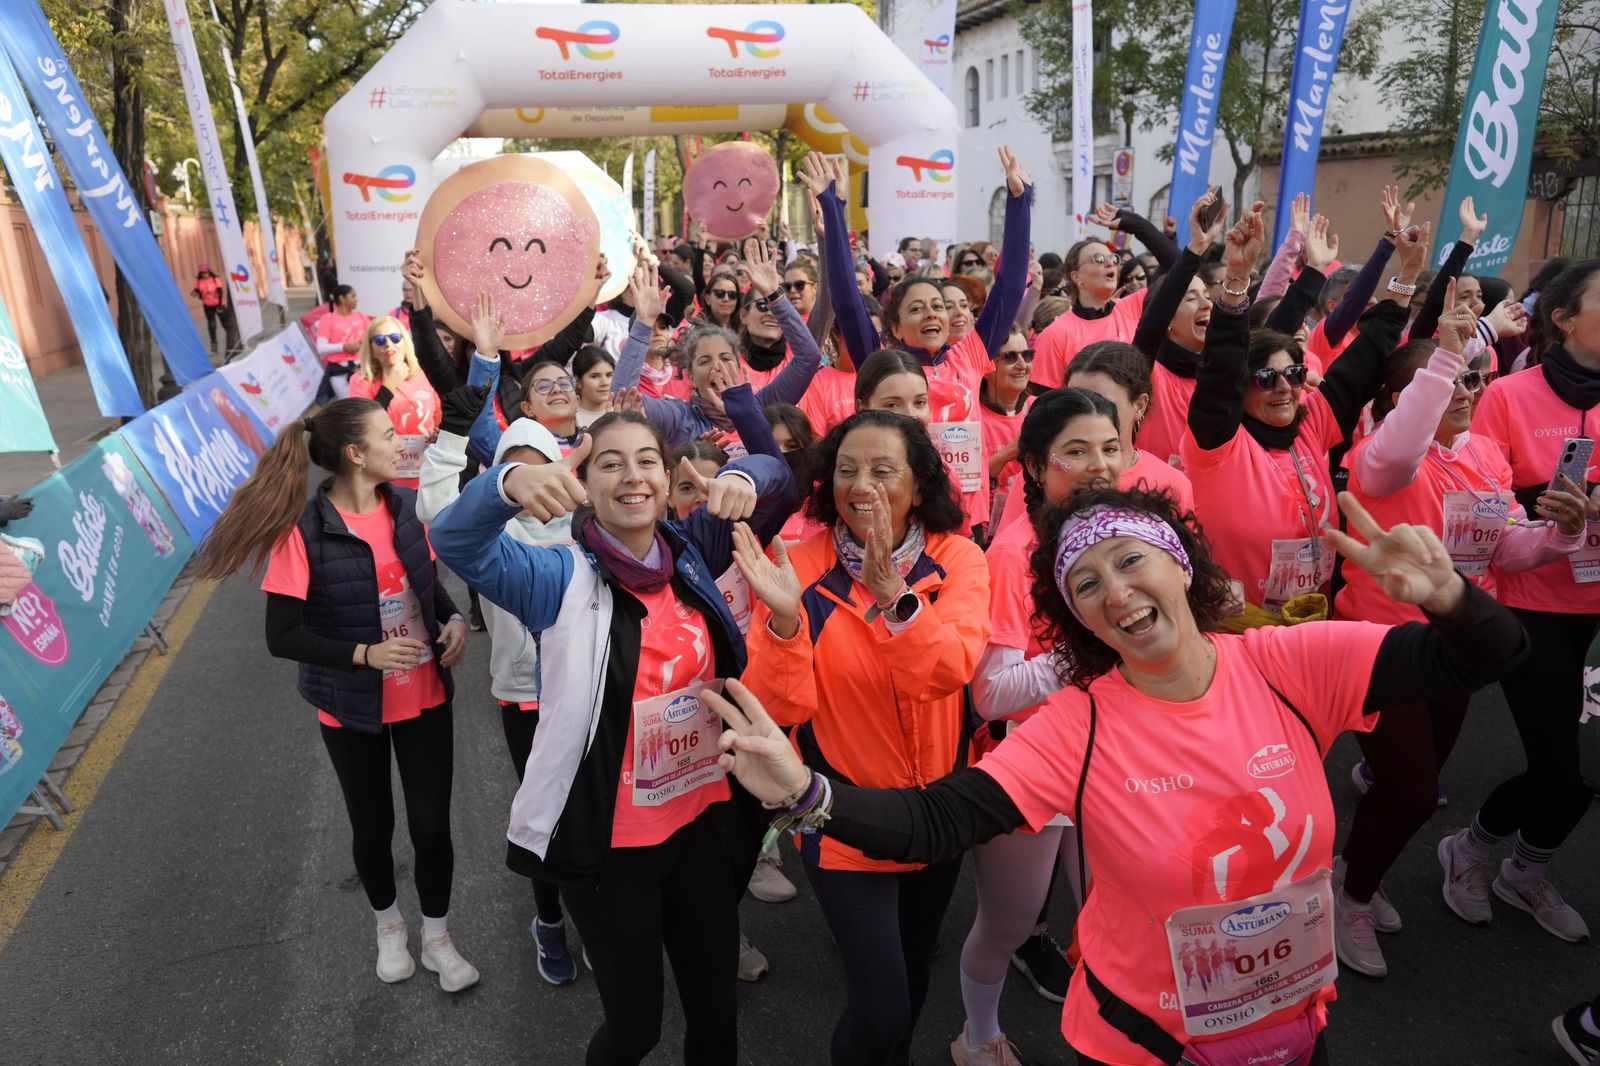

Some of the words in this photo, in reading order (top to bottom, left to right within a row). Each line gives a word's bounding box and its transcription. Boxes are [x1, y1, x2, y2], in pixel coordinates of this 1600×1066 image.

[538, 69, 623, 82] TotalEnergies
[708, 67, 787, 80] TotalEnergies
[1179, 33, 1223, 175] Marlene
[585, 114, 624, 123] Deportes
[943, 432, 969, 440] ASTURIANA
[1534, 427, 1578, 438] OYSHO
[402, 453, 419, 461] 016
[944, 452, 969, 464] 016
[1473, 529, 1499, 542] 016
[58, 490, 107, 602] Batiste
[1298, 568, 1321, 588] 016
[32, 623, 61, 653] ESPAÑA
[382, 624, 409, 641] 016
[666, 704, 699, 720] ASTURIANA
[643, 716, 662, 728] SUMA
[669, 731, 699, 756] 016
[647, 784, 676, 802] OYSHO
[1124, 774, 1195, 795] OYSHO
[1227, 909, 1288, 933] ASTURIANA
[1182, 926, 1217, 937] SUMA
[1235, 939, 1291, 975] 016
[1207, 996, 1243, 1012] CARRERA
[1243, 991, 1254, 1003] DE
[1254, 986, 1265, 999] LA
[1265, 978, 1289, 994] MUJER
[1292, 962, 1319, 981] SEVILLA
[1254, 971, 1280, 988] 1663
[1283, 976, 1325, 1002] Santander
[1204, 1007, 1255, 1028] OYSHO
